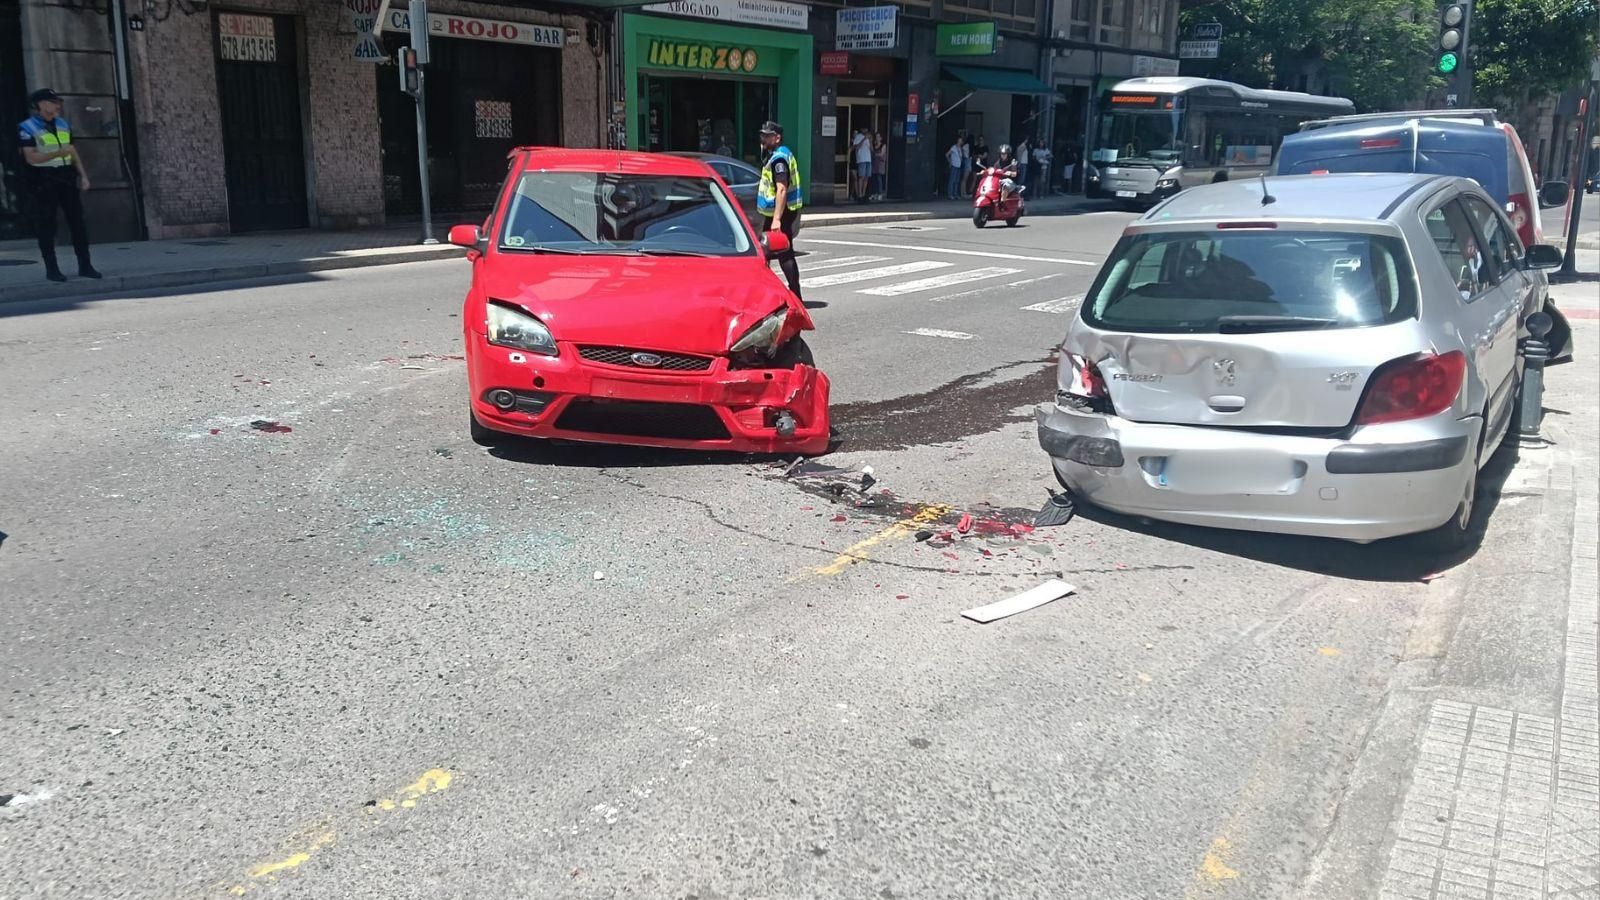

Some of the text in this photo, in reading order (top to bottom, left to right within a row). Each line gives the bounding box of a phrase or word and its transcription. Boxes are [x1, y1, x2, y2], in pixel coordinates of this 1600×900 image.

[667, 1, 719, 17] ABOGADO
[219, 14, 274, 35] SE VENDE
[448, 18, 518, 39] ROJO
[534, 27, 560, 44] BAR
[222, 35, 275, 61] 678 413 515
[354, 39, 380, 57] BAR
[951, 33, 992, 45] NEW HOME
[650, 41, 757, 72] INTERZOO
